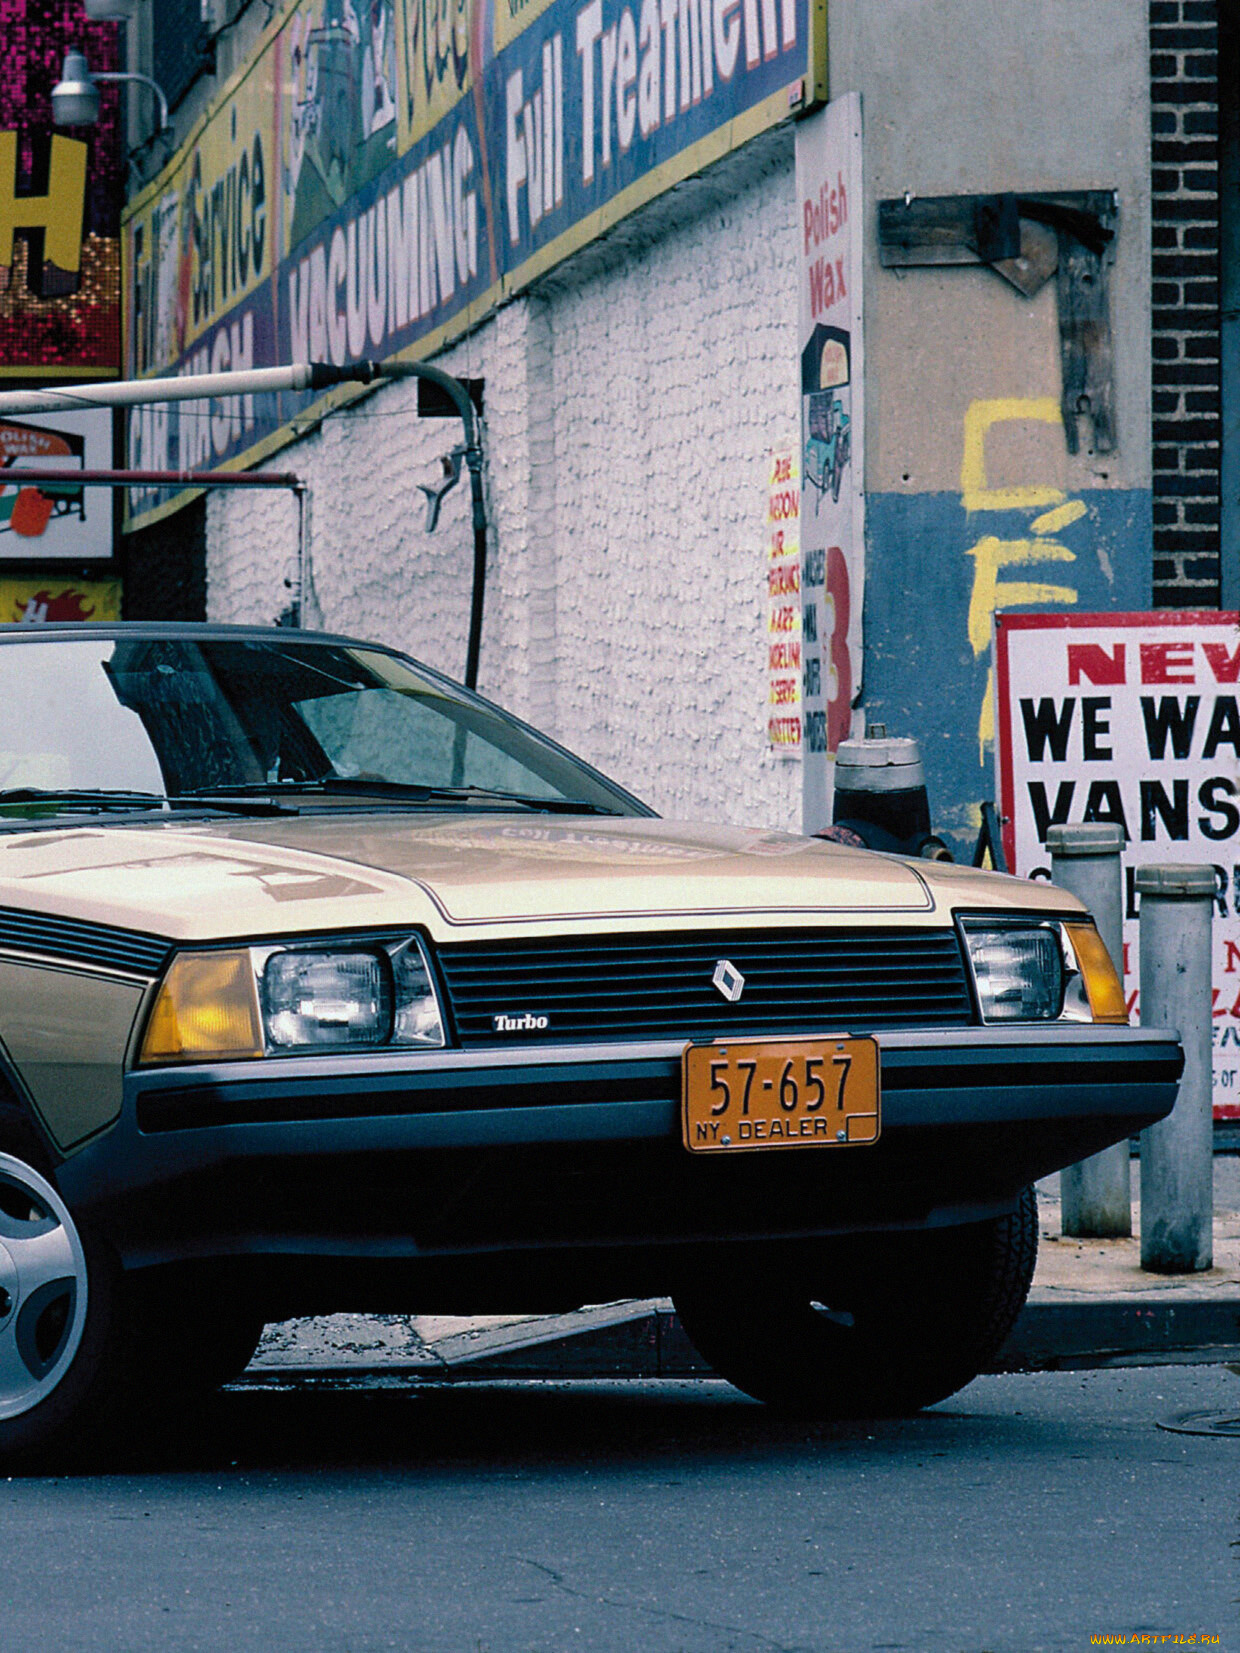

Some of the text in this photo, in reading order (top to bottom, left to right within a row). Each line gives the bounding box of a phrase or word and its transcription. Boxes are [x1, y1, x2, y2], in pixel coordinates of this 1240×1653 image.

[506, 34, 564, 247] Full
[289, 121, 476, 367] VACUUMING
[803, 170, 848, 256] Polish
[809, 253, 847, 318] Wax
[4, 443, 37, 454] WAX
[1019, 695, 1240, 762] WE WA
[1027, 777, 1240, 844] VANS
[494, 1013, 549, 1032] Turbo
[709, 1058, 853, 1116] 57-657
[696, 1117, 828, 1141] NY DEALER
